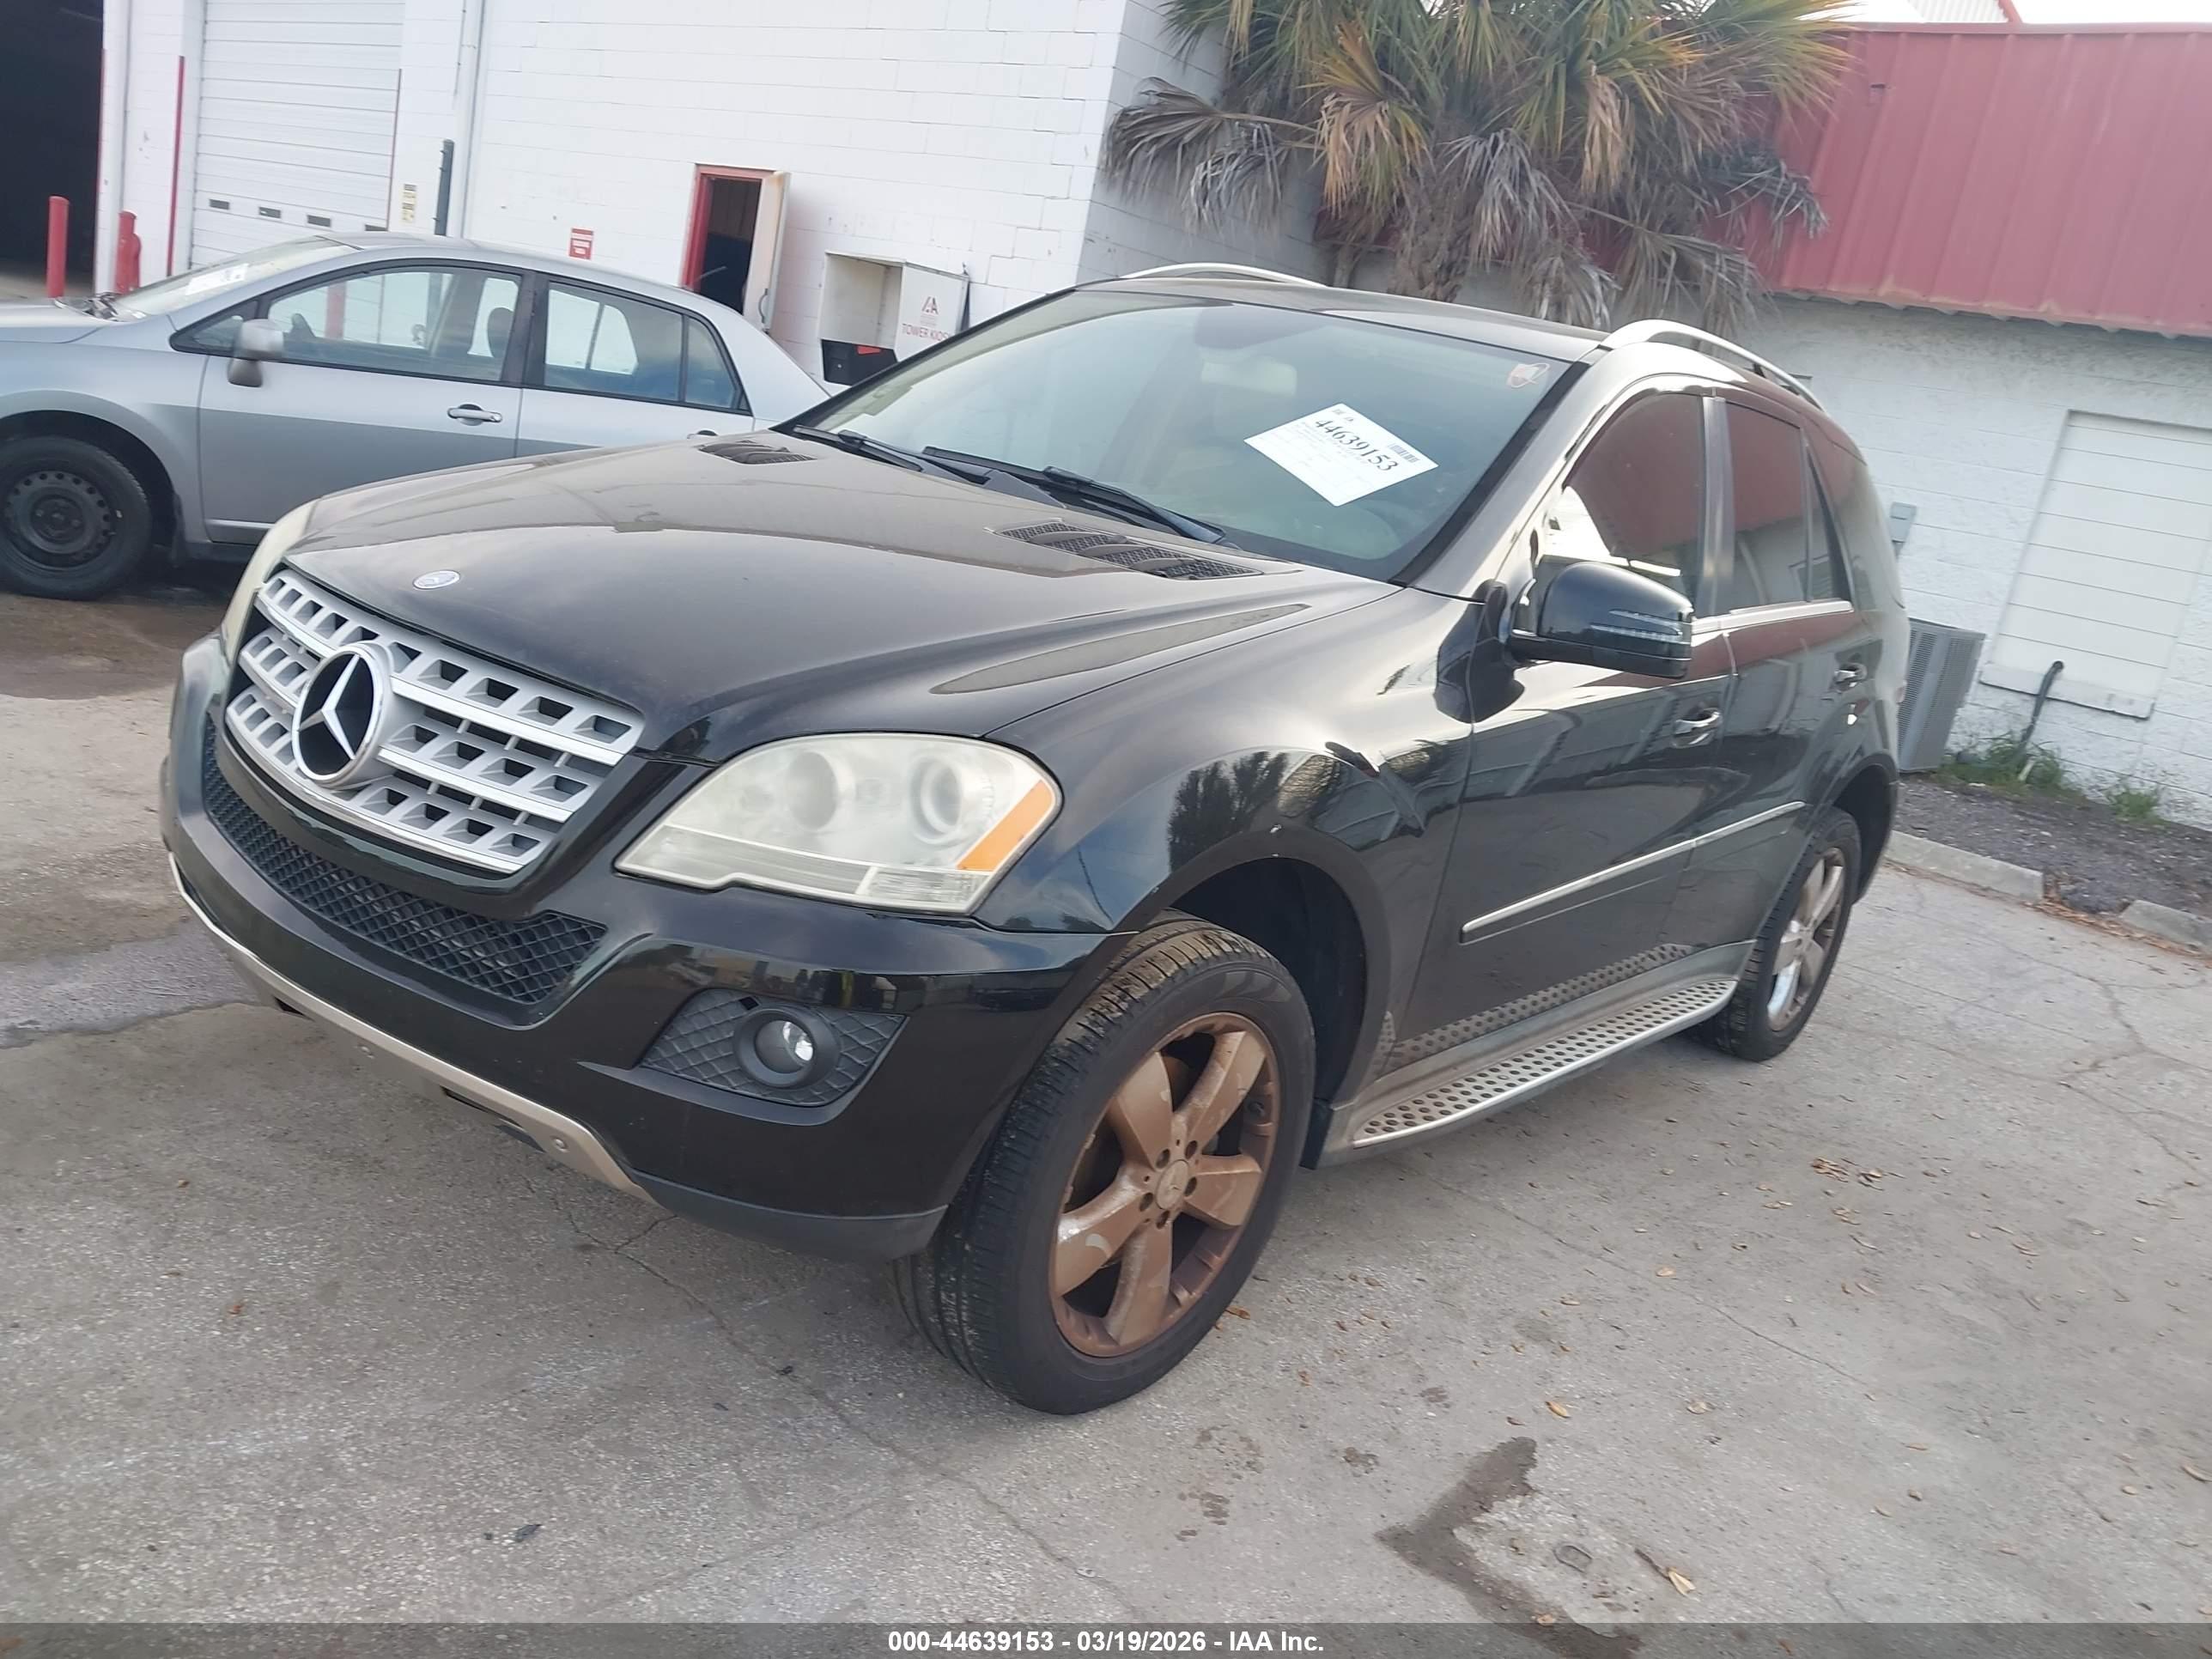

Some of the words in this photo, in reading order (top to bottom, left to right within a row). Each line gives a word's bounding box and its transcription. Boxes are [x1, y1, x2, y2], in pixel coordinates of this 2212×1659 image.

[902, 323, 929, 339] TOWER
[929, 330, 951, 342] KIOS
[1315, 421, 1399, 471] 44639153
